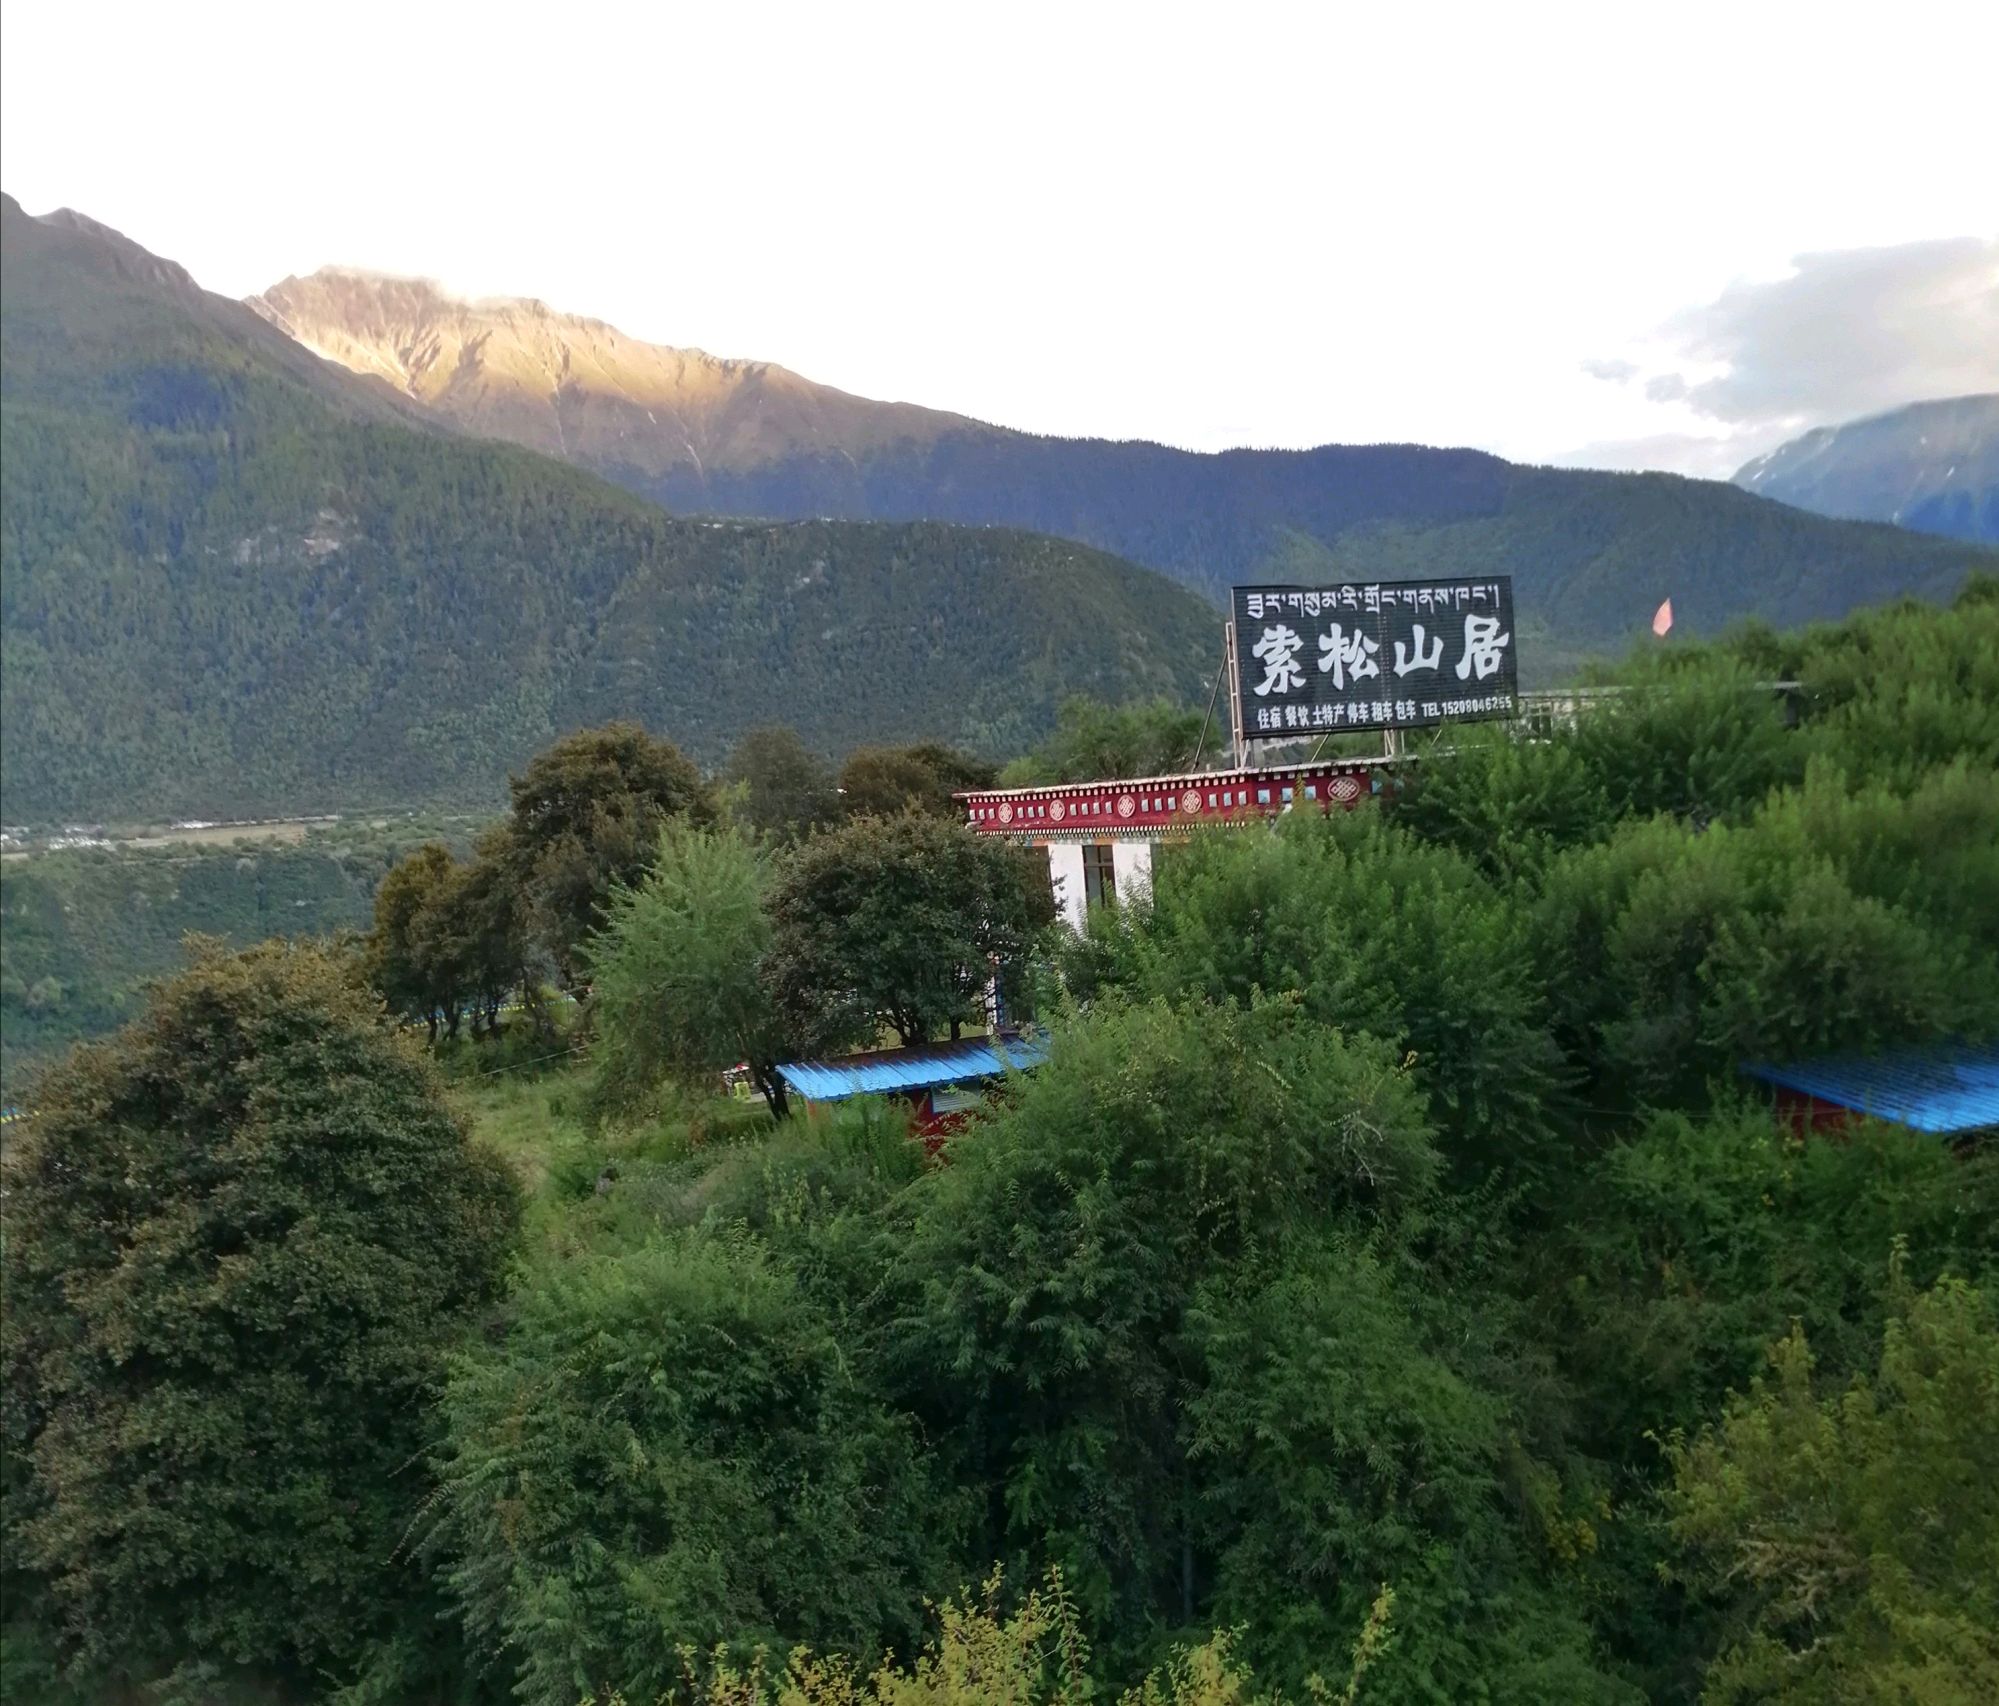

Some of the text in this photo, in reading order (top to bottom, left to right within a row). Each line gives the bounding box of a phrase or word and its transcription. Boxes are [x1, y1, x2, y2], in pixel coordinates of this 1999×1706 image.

[1252, 613, 1510, 696] 索松山居
[1257, 708, 1282, 729] 住宿
[1285, 705, 1309, 727] 餐饮
[1313, 703, 1345, 725] 土特产
[1347, 702, 1369, 723] 停车
[1371, 701, 1393, 721] 租车
[1395, 699, 1416, 720] 包车
[1421, 702, 1441, 717] TEL
